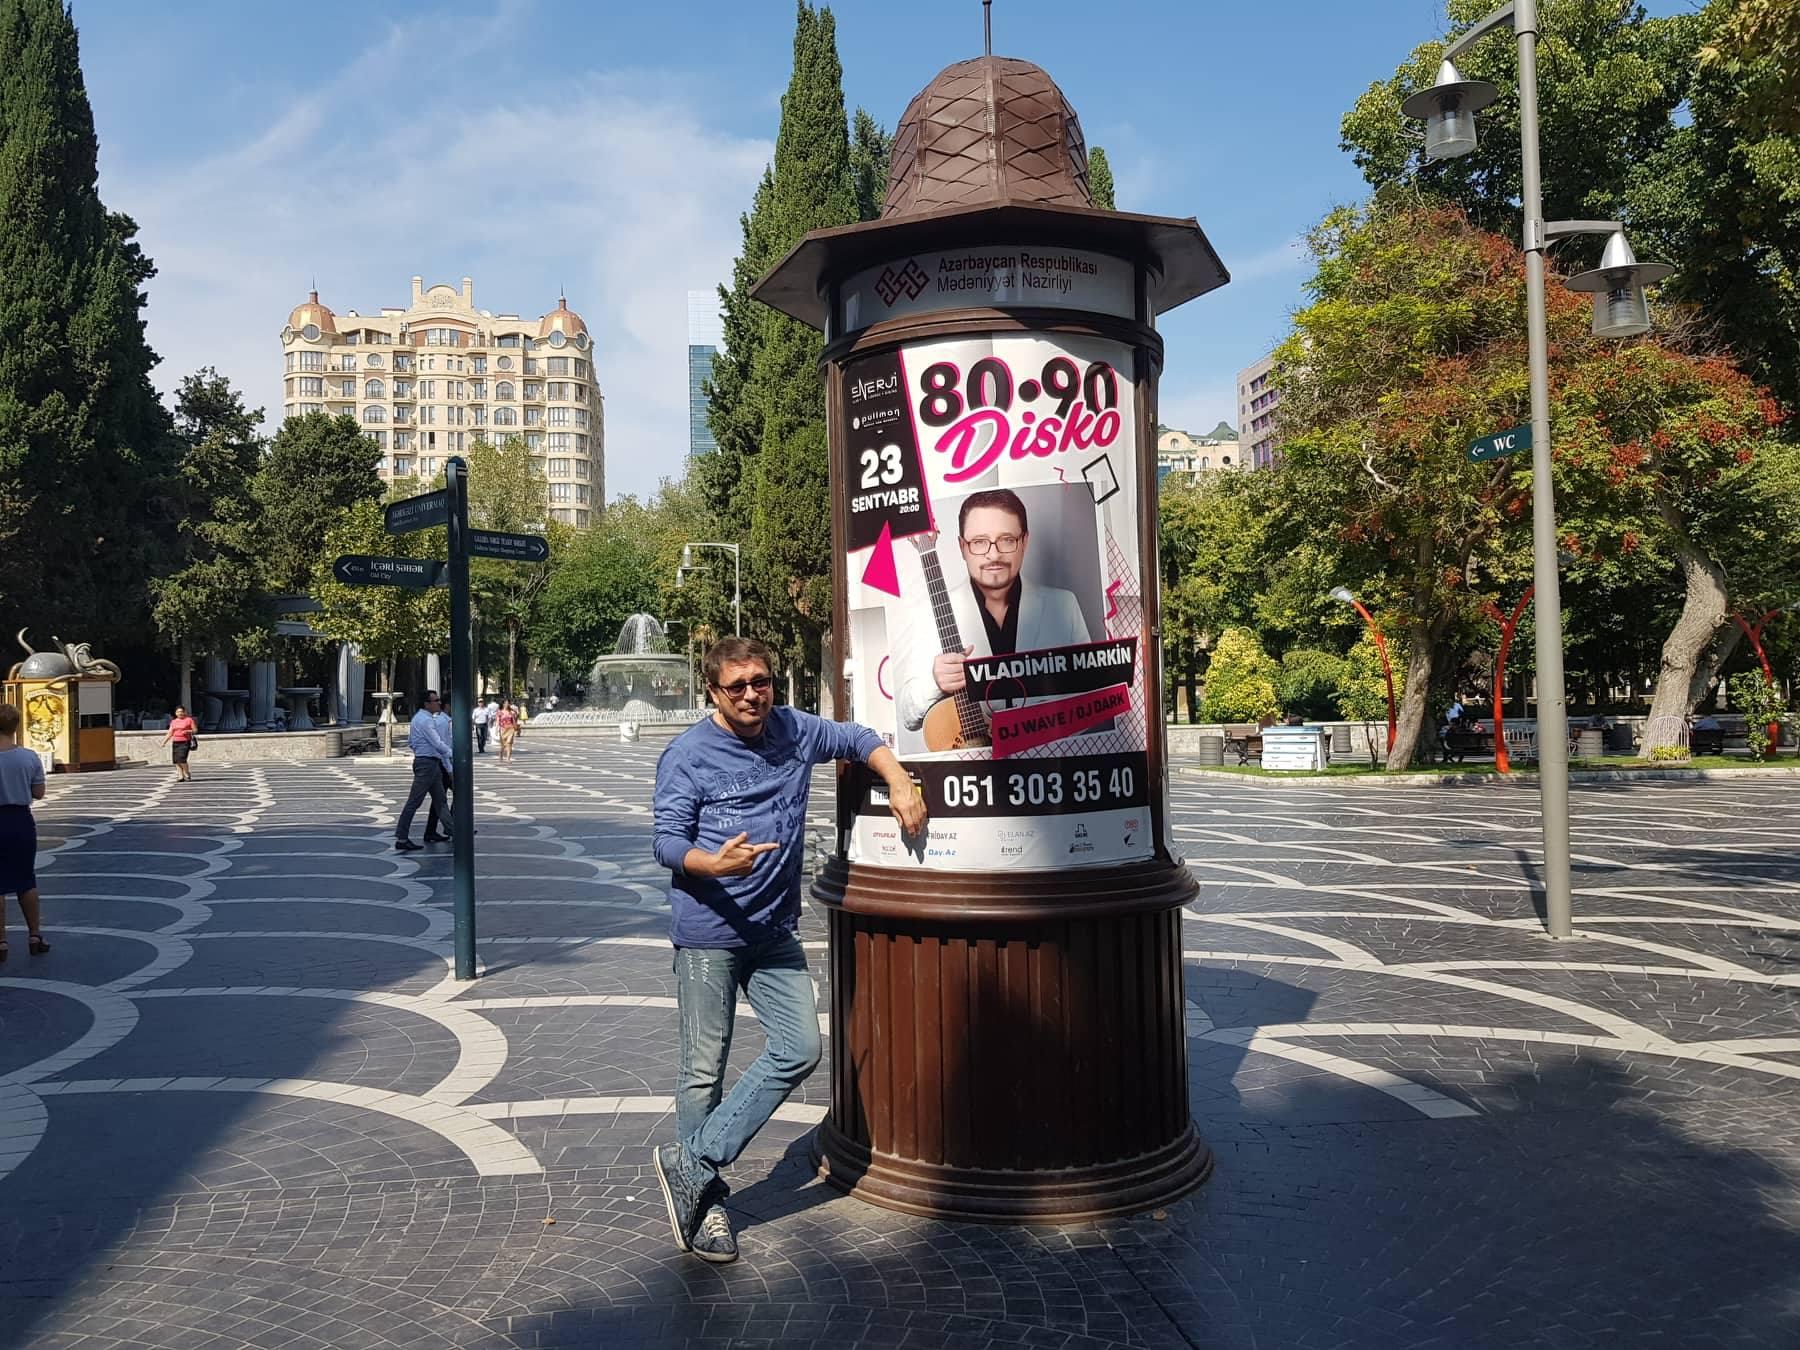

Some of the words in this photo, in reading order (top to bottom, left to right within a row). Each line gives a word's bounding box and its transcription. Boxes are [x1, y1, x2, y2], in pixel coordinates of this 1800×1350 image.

[938, 254, 1016, 274] Azərbaycan
[1020, 252, 1098, 276] Respublikası
[937, 271, 1015, 293] Mədəniyyət
[934, 401, 1121, 483] Disko
[1493, 434, 1516, 452] WC
[860, 443, 904, 490] 23
[851, 487, 919, 513] SENTYABR
[898, 503, 920, 514] 20:00
[968, 651, 1068, 683] VLADİMİR
[1072, 643, 1132, 671] MARKİN
[997, 726, 1019, 741] DJ
[1021, 711, 1067, 734] WAVE
[1075, 705, 1094, 721] DJ
[1094, 692, 1126, 714] DARK
[943, 775, 994, 807] 051
[1008, 772, 1063, 806] 303
[1072, 769, 1101, 803] 35
[1108, 766, 1134, 798] 40
